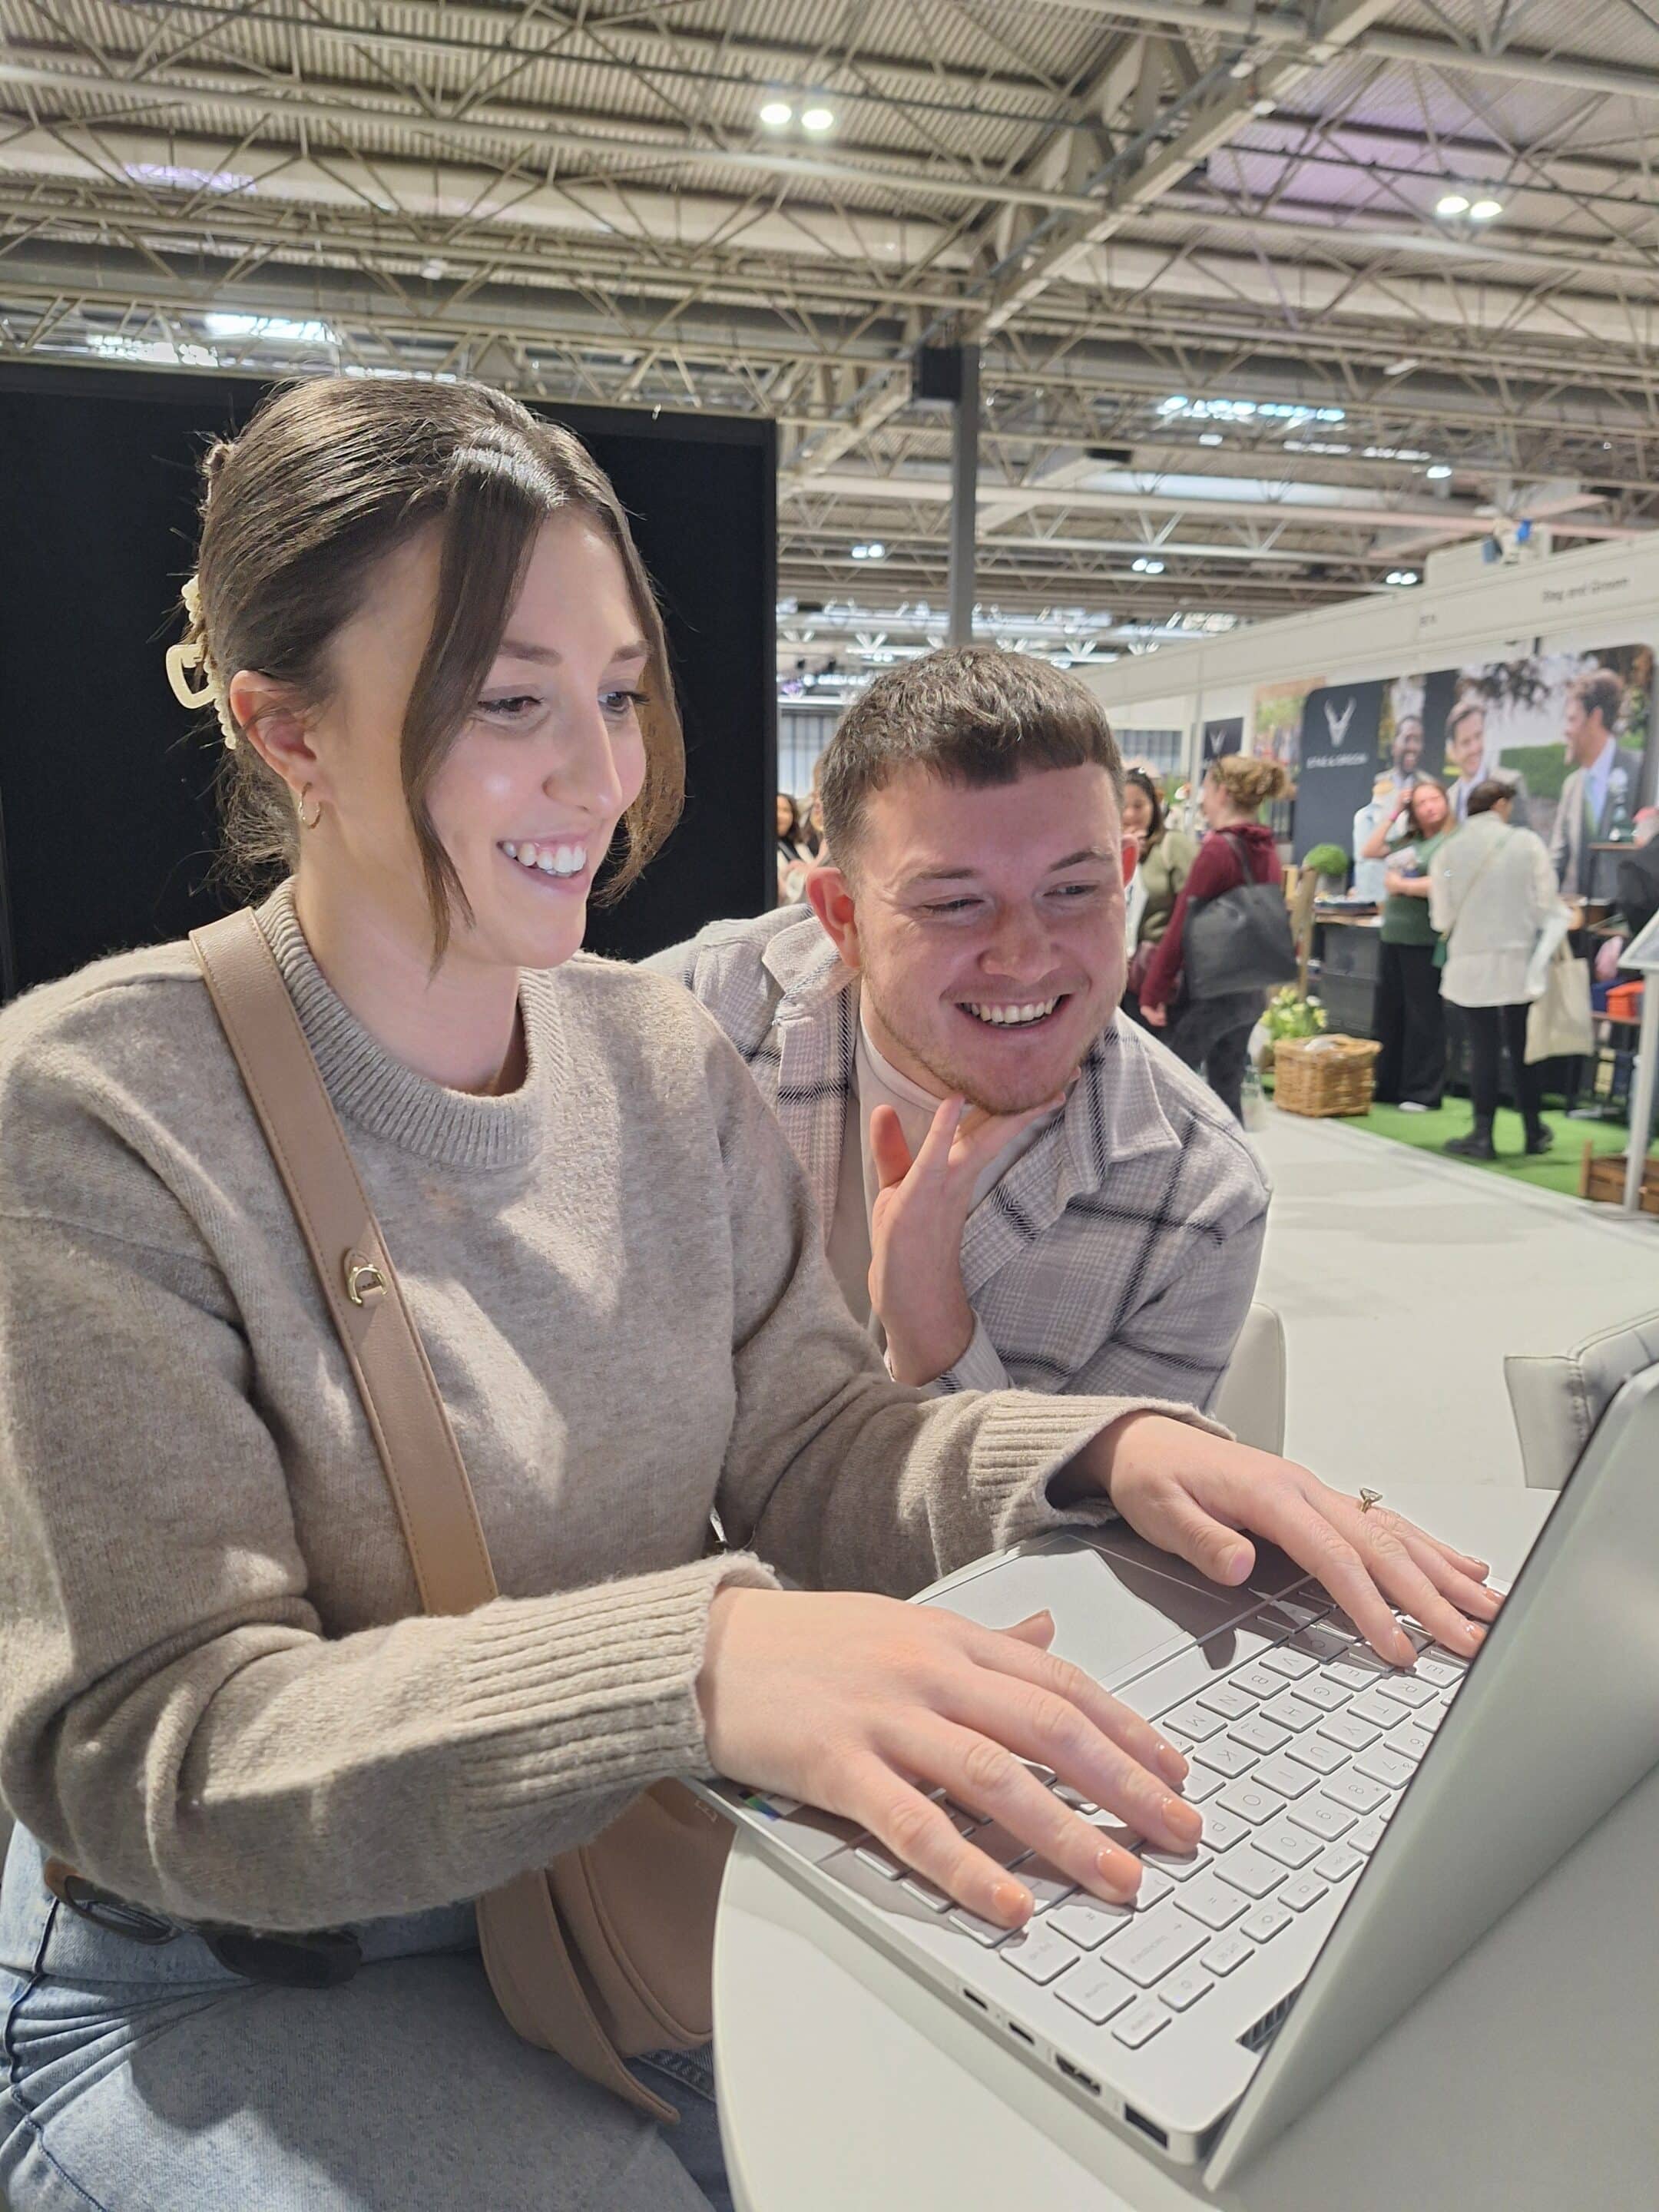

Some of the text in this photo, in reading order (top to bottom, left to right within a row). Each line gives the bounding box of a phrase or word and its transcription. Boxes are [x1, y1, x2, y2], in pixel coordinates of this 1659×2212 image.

[1251, 1674, 1269, 1685] B
[1313, 1685, 1330, 1696] G
[1282, 1705, 1301, 1717] H
